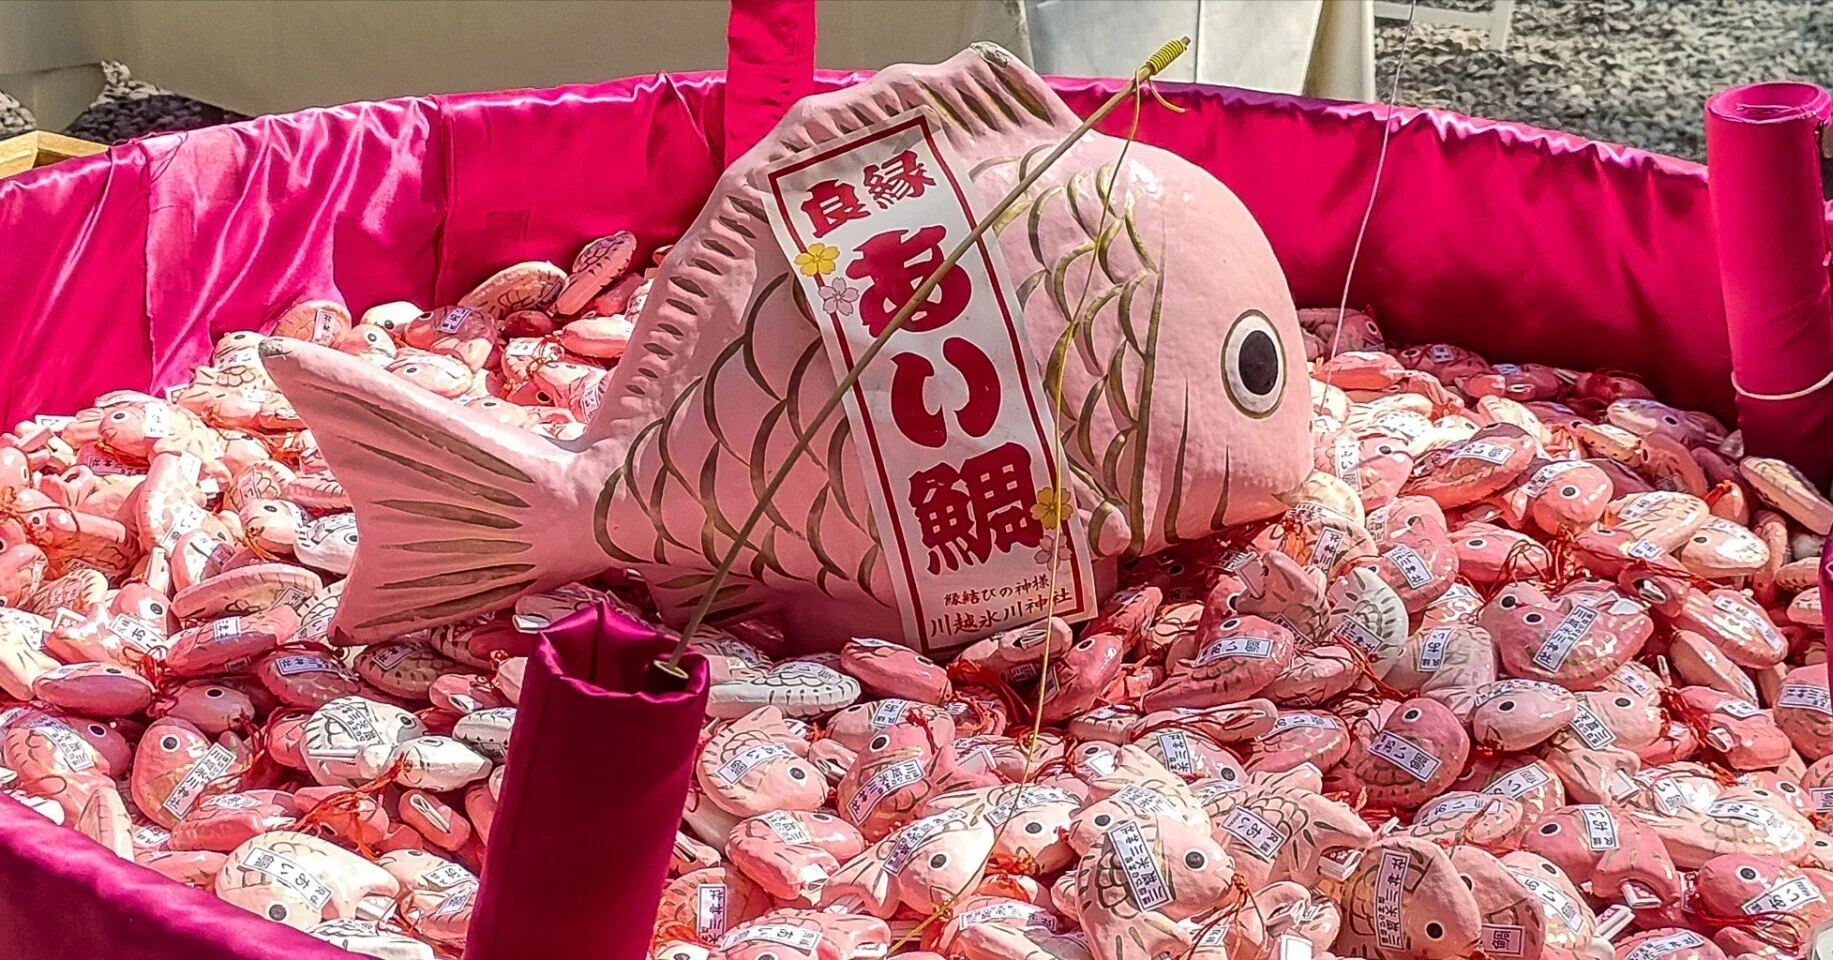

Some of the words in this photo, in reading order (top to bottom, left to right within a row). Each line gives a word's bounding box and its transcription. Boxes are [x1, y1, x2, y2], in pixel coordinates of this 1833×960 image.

[800, 148, 937, 239] 良縁
[848, 224, 1044, 575] あい鯛
[930, 588, 1073, 638] 川越氷川神社
[944, 574, 1050, 607] 縁結びの神様
